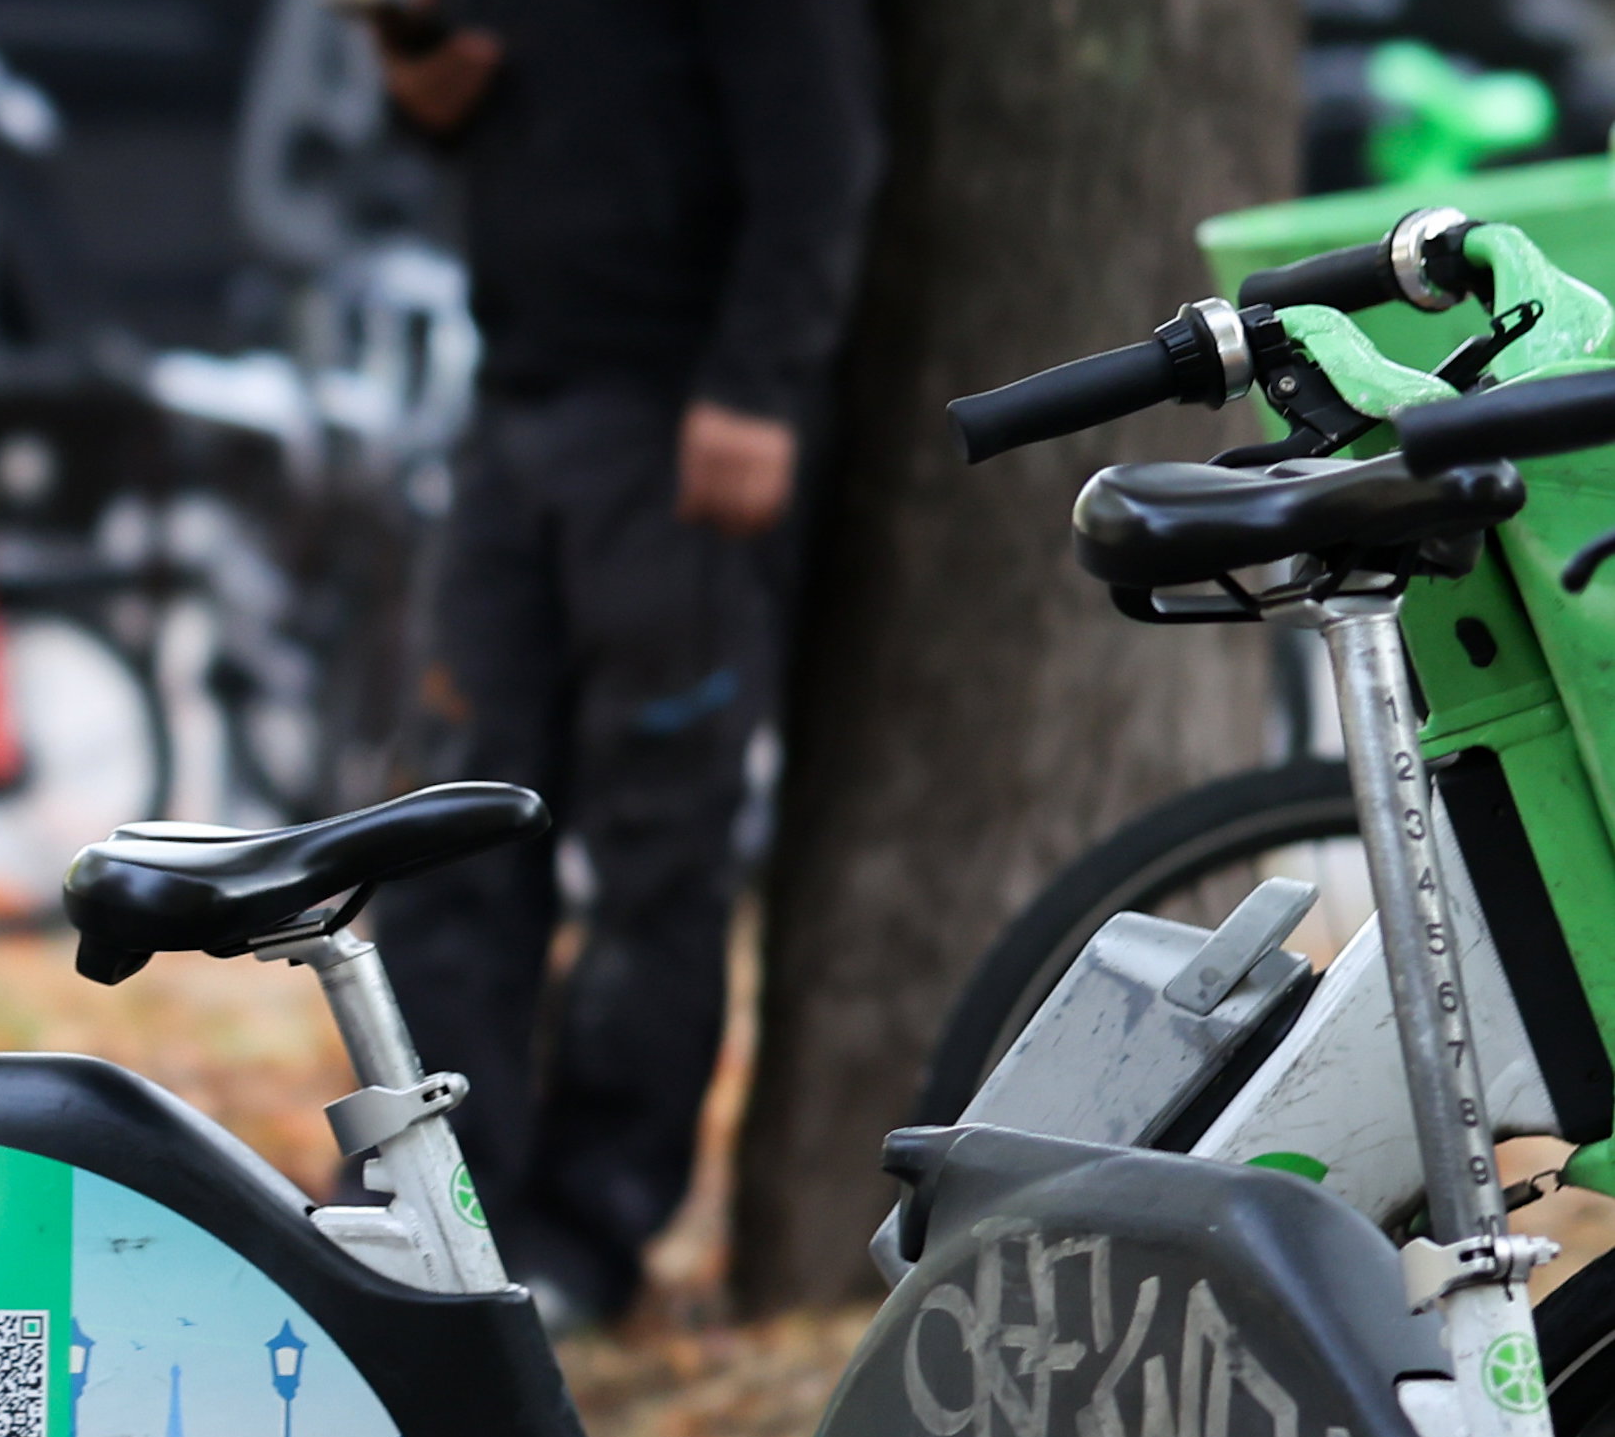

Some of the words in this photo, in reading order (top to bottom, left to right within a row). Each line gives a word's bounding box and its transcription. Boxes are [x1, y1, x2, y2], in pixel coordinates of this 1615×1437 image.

[1385, 695, 1400, 724] 1
[1393, 751, 1416, 781] 2
[1405, 809, 1427, 840] 3
[1417, 867, 1436, 897] 4
[1426, 924, 1447, 955] 5
[1437, 981, 1459, 1012] 6
[1447, 1040, 1465, 1069] 7
[1458, 1098, 1479, 1127] 8
[1470, 1156, 1489, 1185] 9
